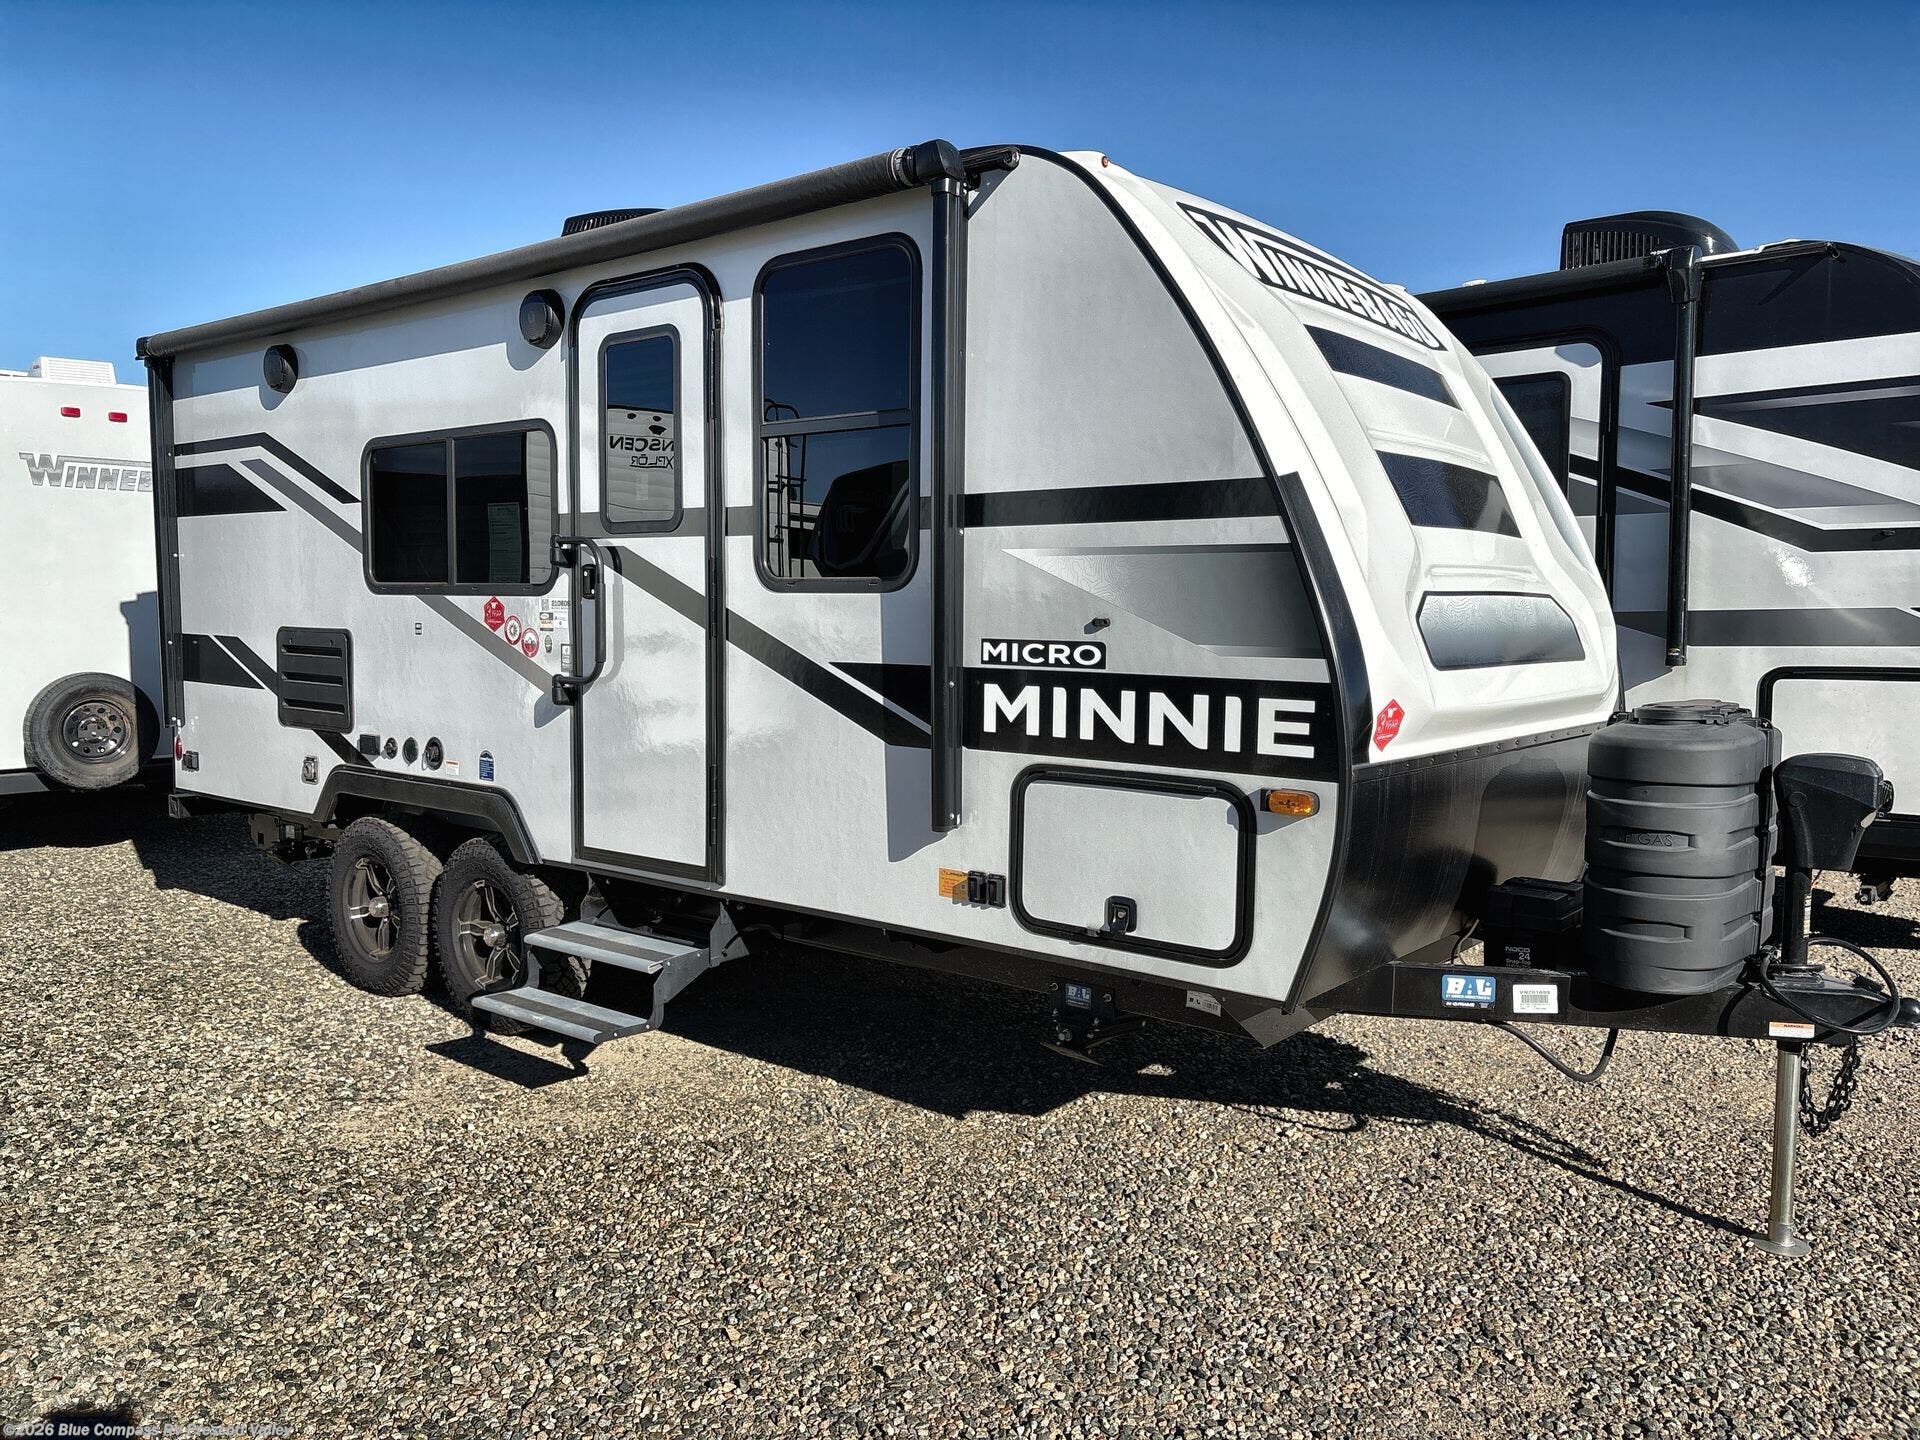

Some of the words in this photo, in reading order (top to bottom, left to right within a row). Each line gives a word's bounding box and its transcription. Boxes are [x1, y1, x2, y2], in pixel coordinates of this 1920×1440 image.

[1184, 208, 1442, 349] WINNEBAGO
[18, 452, 153, 493] WINNEB
[982, 641, 1102, 666] MICRO
[983, 683, 1316, 759] MINNIE
[1637, 832, 1674, 847] GAS
[1518, 952, 1531, 960] 24
